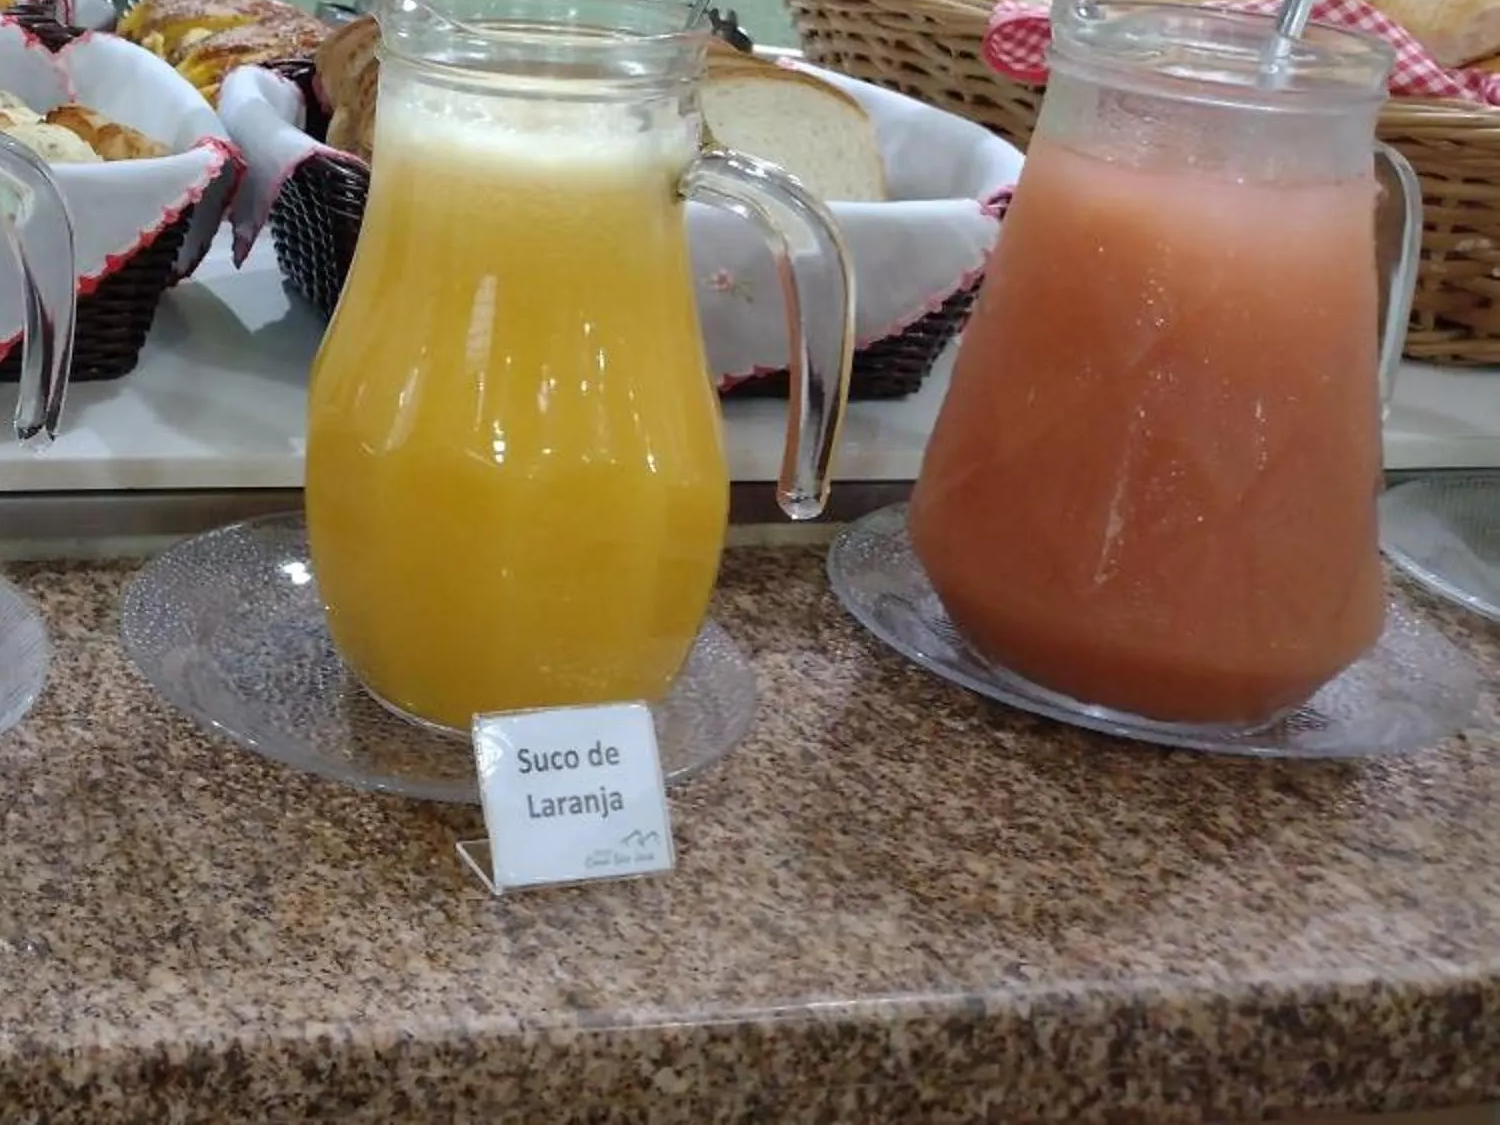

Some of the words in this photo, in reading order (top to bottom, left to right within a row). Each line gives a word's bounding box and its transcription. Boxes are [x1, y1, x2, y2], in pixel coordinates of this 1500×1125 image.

[517, 747, 580, 774] Suco
[588, 740, 620, 767] de
[527, 786, 625, 819] Laranja
